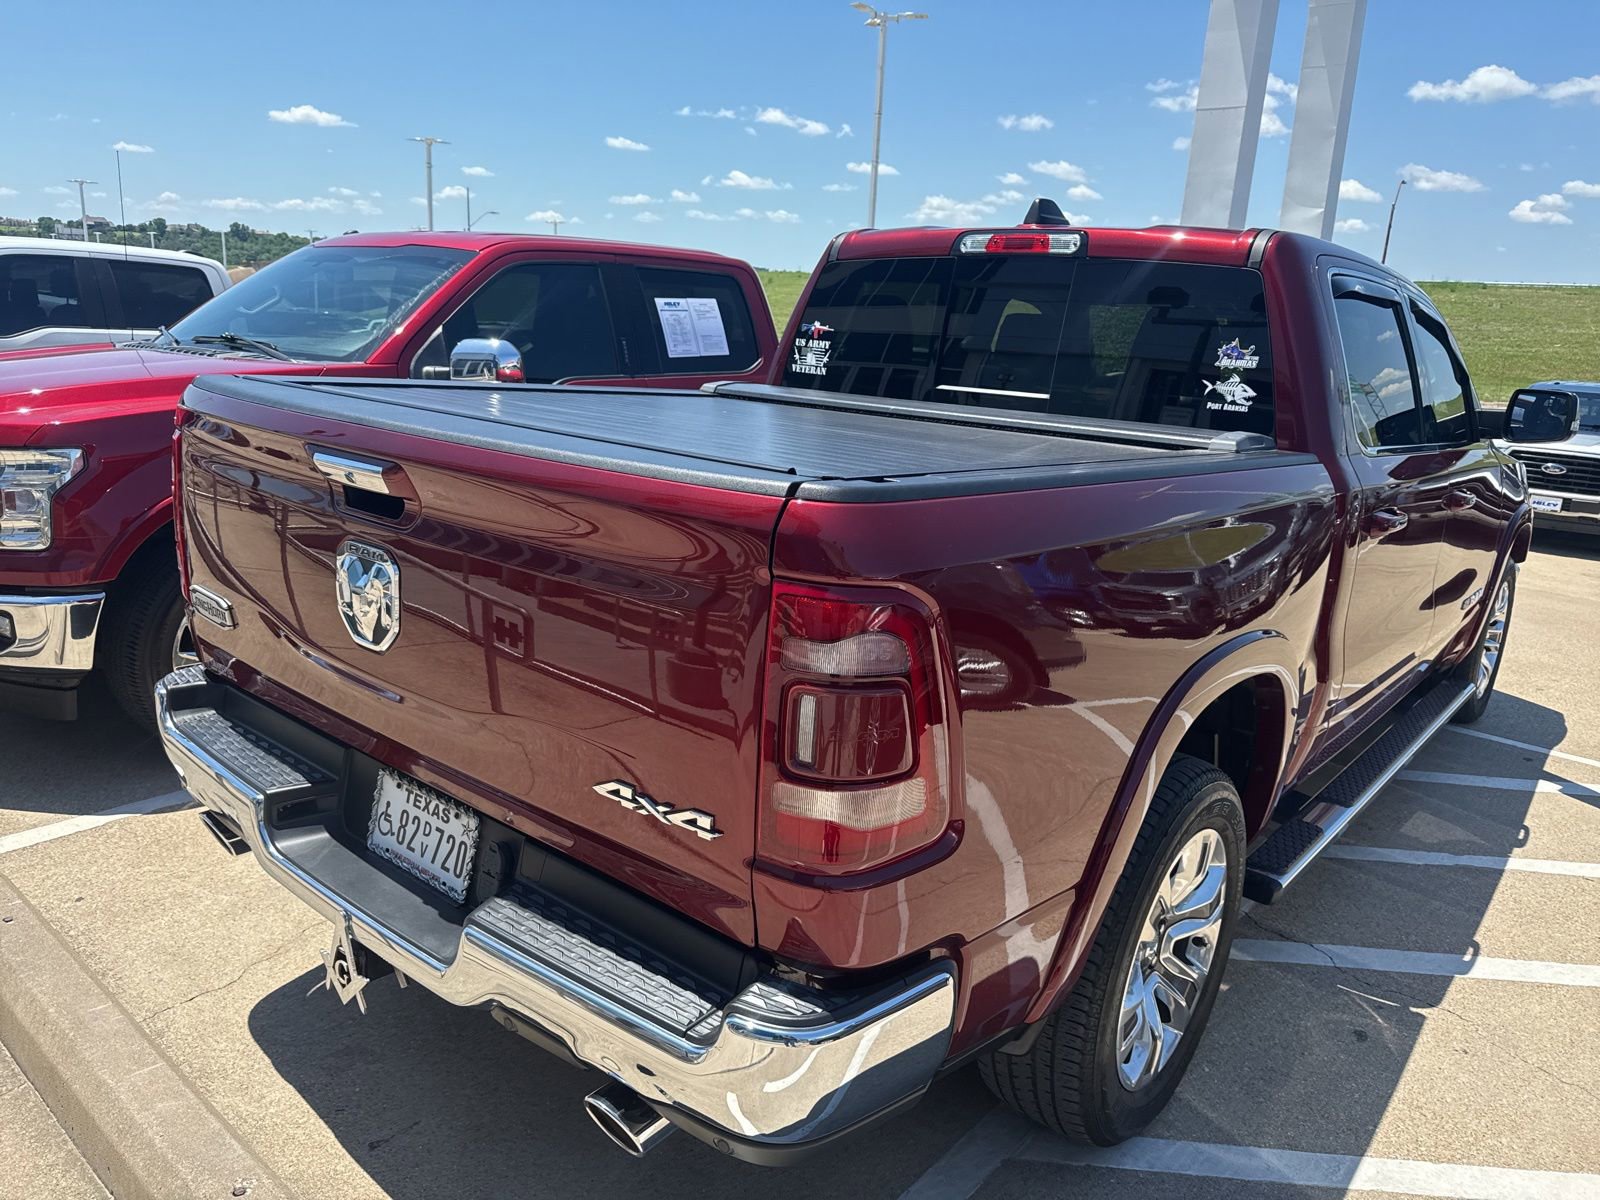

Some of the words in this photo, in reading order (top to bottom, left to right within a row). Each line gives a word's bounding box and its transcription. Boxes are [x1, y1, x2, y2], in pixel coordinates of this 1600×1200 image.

[795, 338, 807, 347] US
[807, 339, 831, 349] ARMY
[791, 363, 828, 376] VETERAN
[1220, 358, 1258, 369] BRAHMAS
[1206, 402, 1223, 410] PORT
[345, 543, 390, 562] RAM
[405, 787, 451, 825] TEXAS
